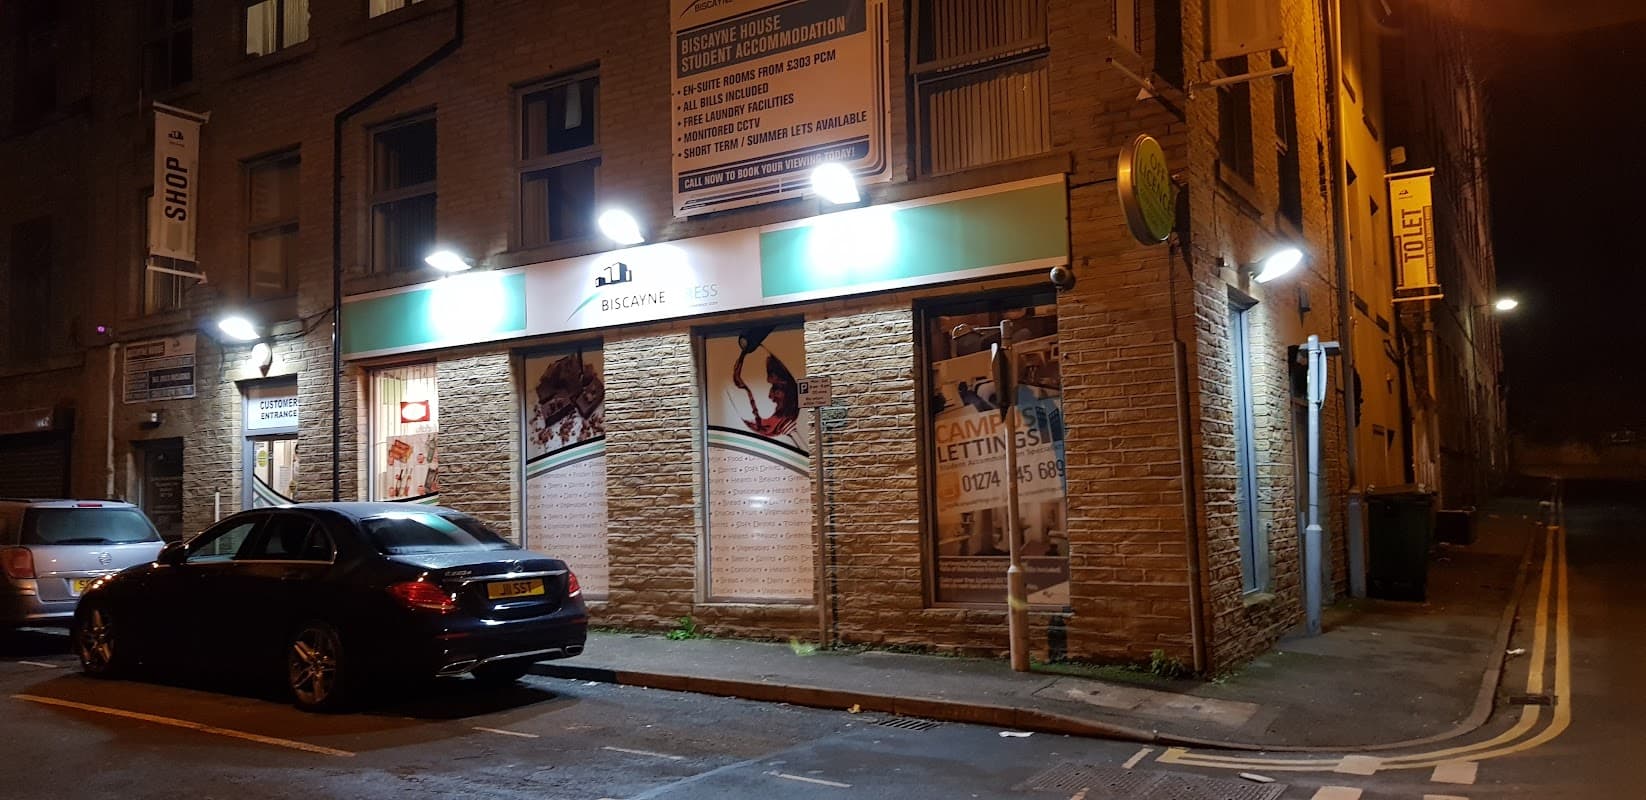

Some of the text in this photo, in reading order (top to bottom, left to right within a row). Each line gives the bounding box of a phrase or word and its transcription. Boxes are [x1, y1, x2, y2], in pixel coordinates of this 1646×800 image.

[681, 15, 781, 55] BISCAYNE HOUSE
[681, 16, 846, 73] STUDENT ACCOMMODATION
[683, 49, 836, 96] EN-SUITE ROOMS FROM £303 PCM
[683, 82, 769, 112] ALL BILLS INCLUDED
[683, 93, 795, 128] FREE LAUNDRY FACILITIES
[683, 117, 761, 143] MONITORED CCTV
[684, 144, 711, 159] SHORT
[714, 137, 739, 153] TERM
[747, 129, 788, 146] SUMMER
[791, 121, 814, 137] LETS
[815, 110, 868, 132] AVAILABLE
[684, 145, 855, 189] CALL NOW TO BOOK YOUR VIEWING TODAY!
[164, 156, 188, 222] SHOP
[602, 291, 666, 311] BISCAYNE
[260, 398, 298, 410] CUSTOMER
[260, 410, 298, 420] ENTRANCE
[962, 469, 1001, 492] 01274
[1038, 459, 1065, 480] 689
